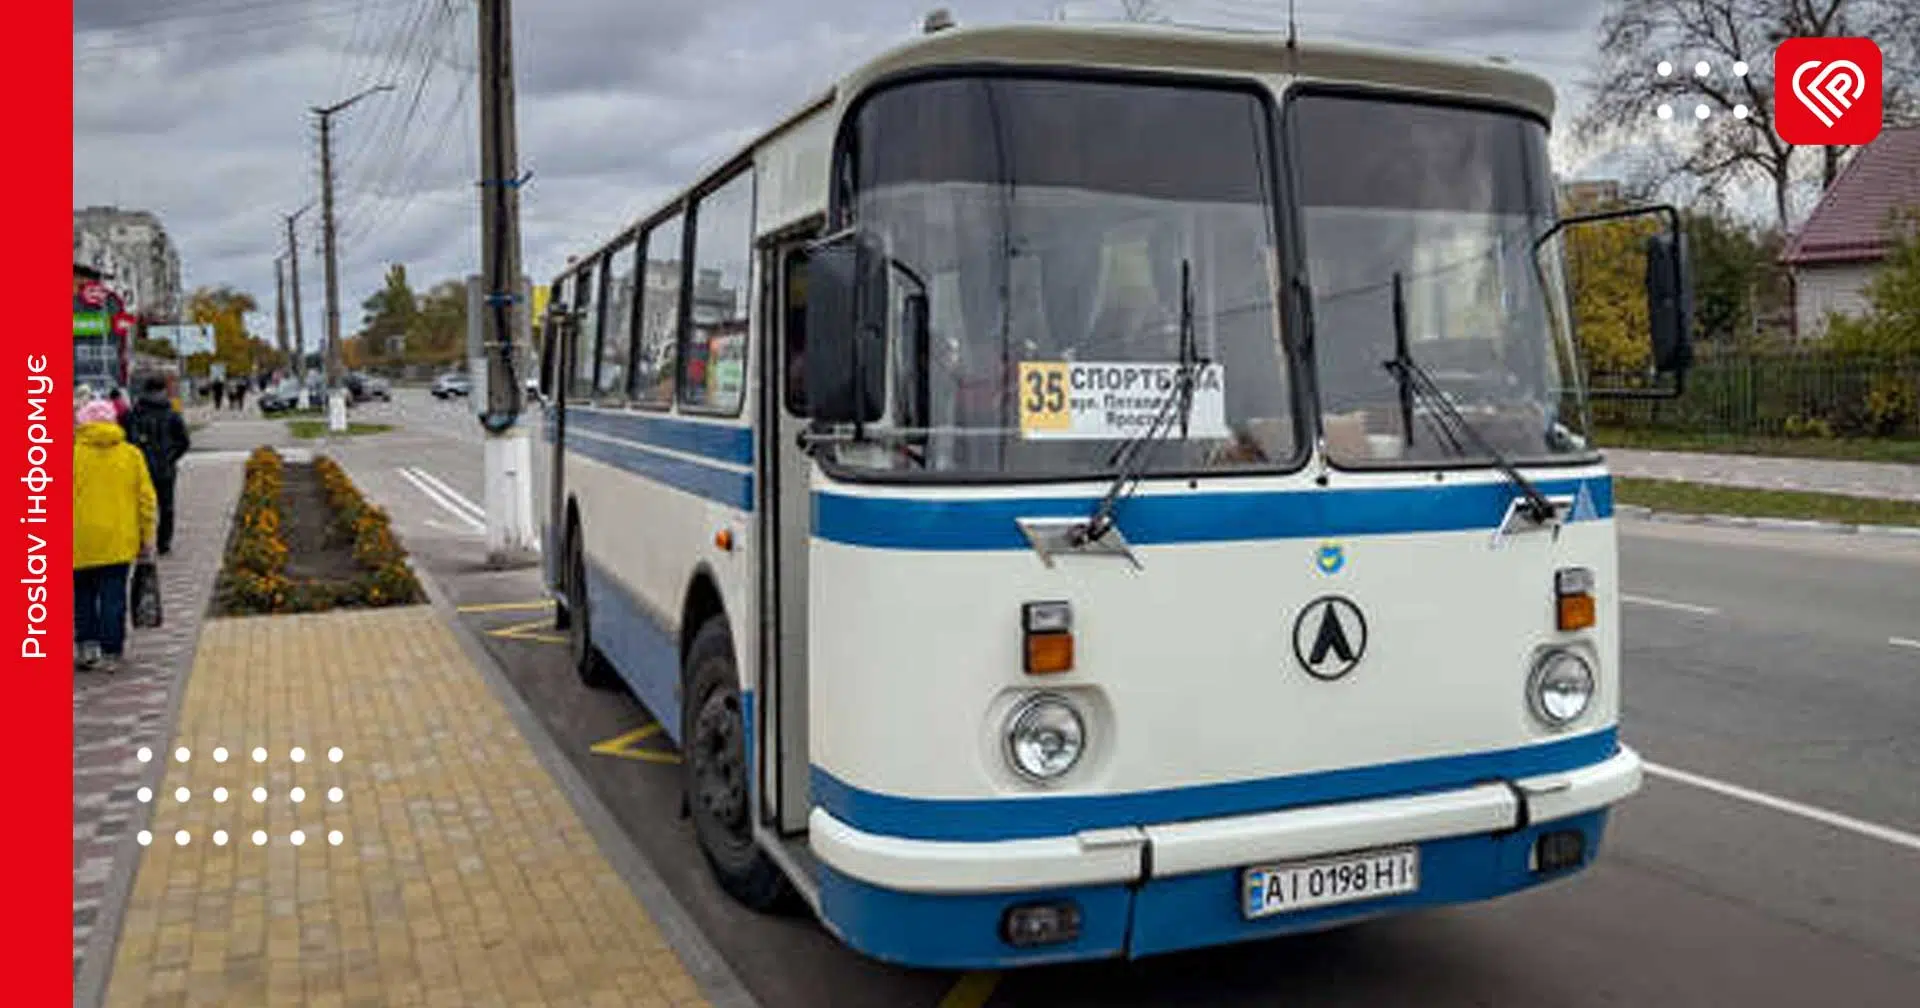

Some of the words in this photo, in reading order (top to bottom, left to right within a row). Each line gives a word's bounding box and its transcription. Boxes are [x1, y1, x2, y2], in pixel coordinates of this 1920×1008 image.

[1026, 369, 1065, 413] 35
[1266, 872, 1298, 905] AI
[1308, 862, 1368, 897] 0198
